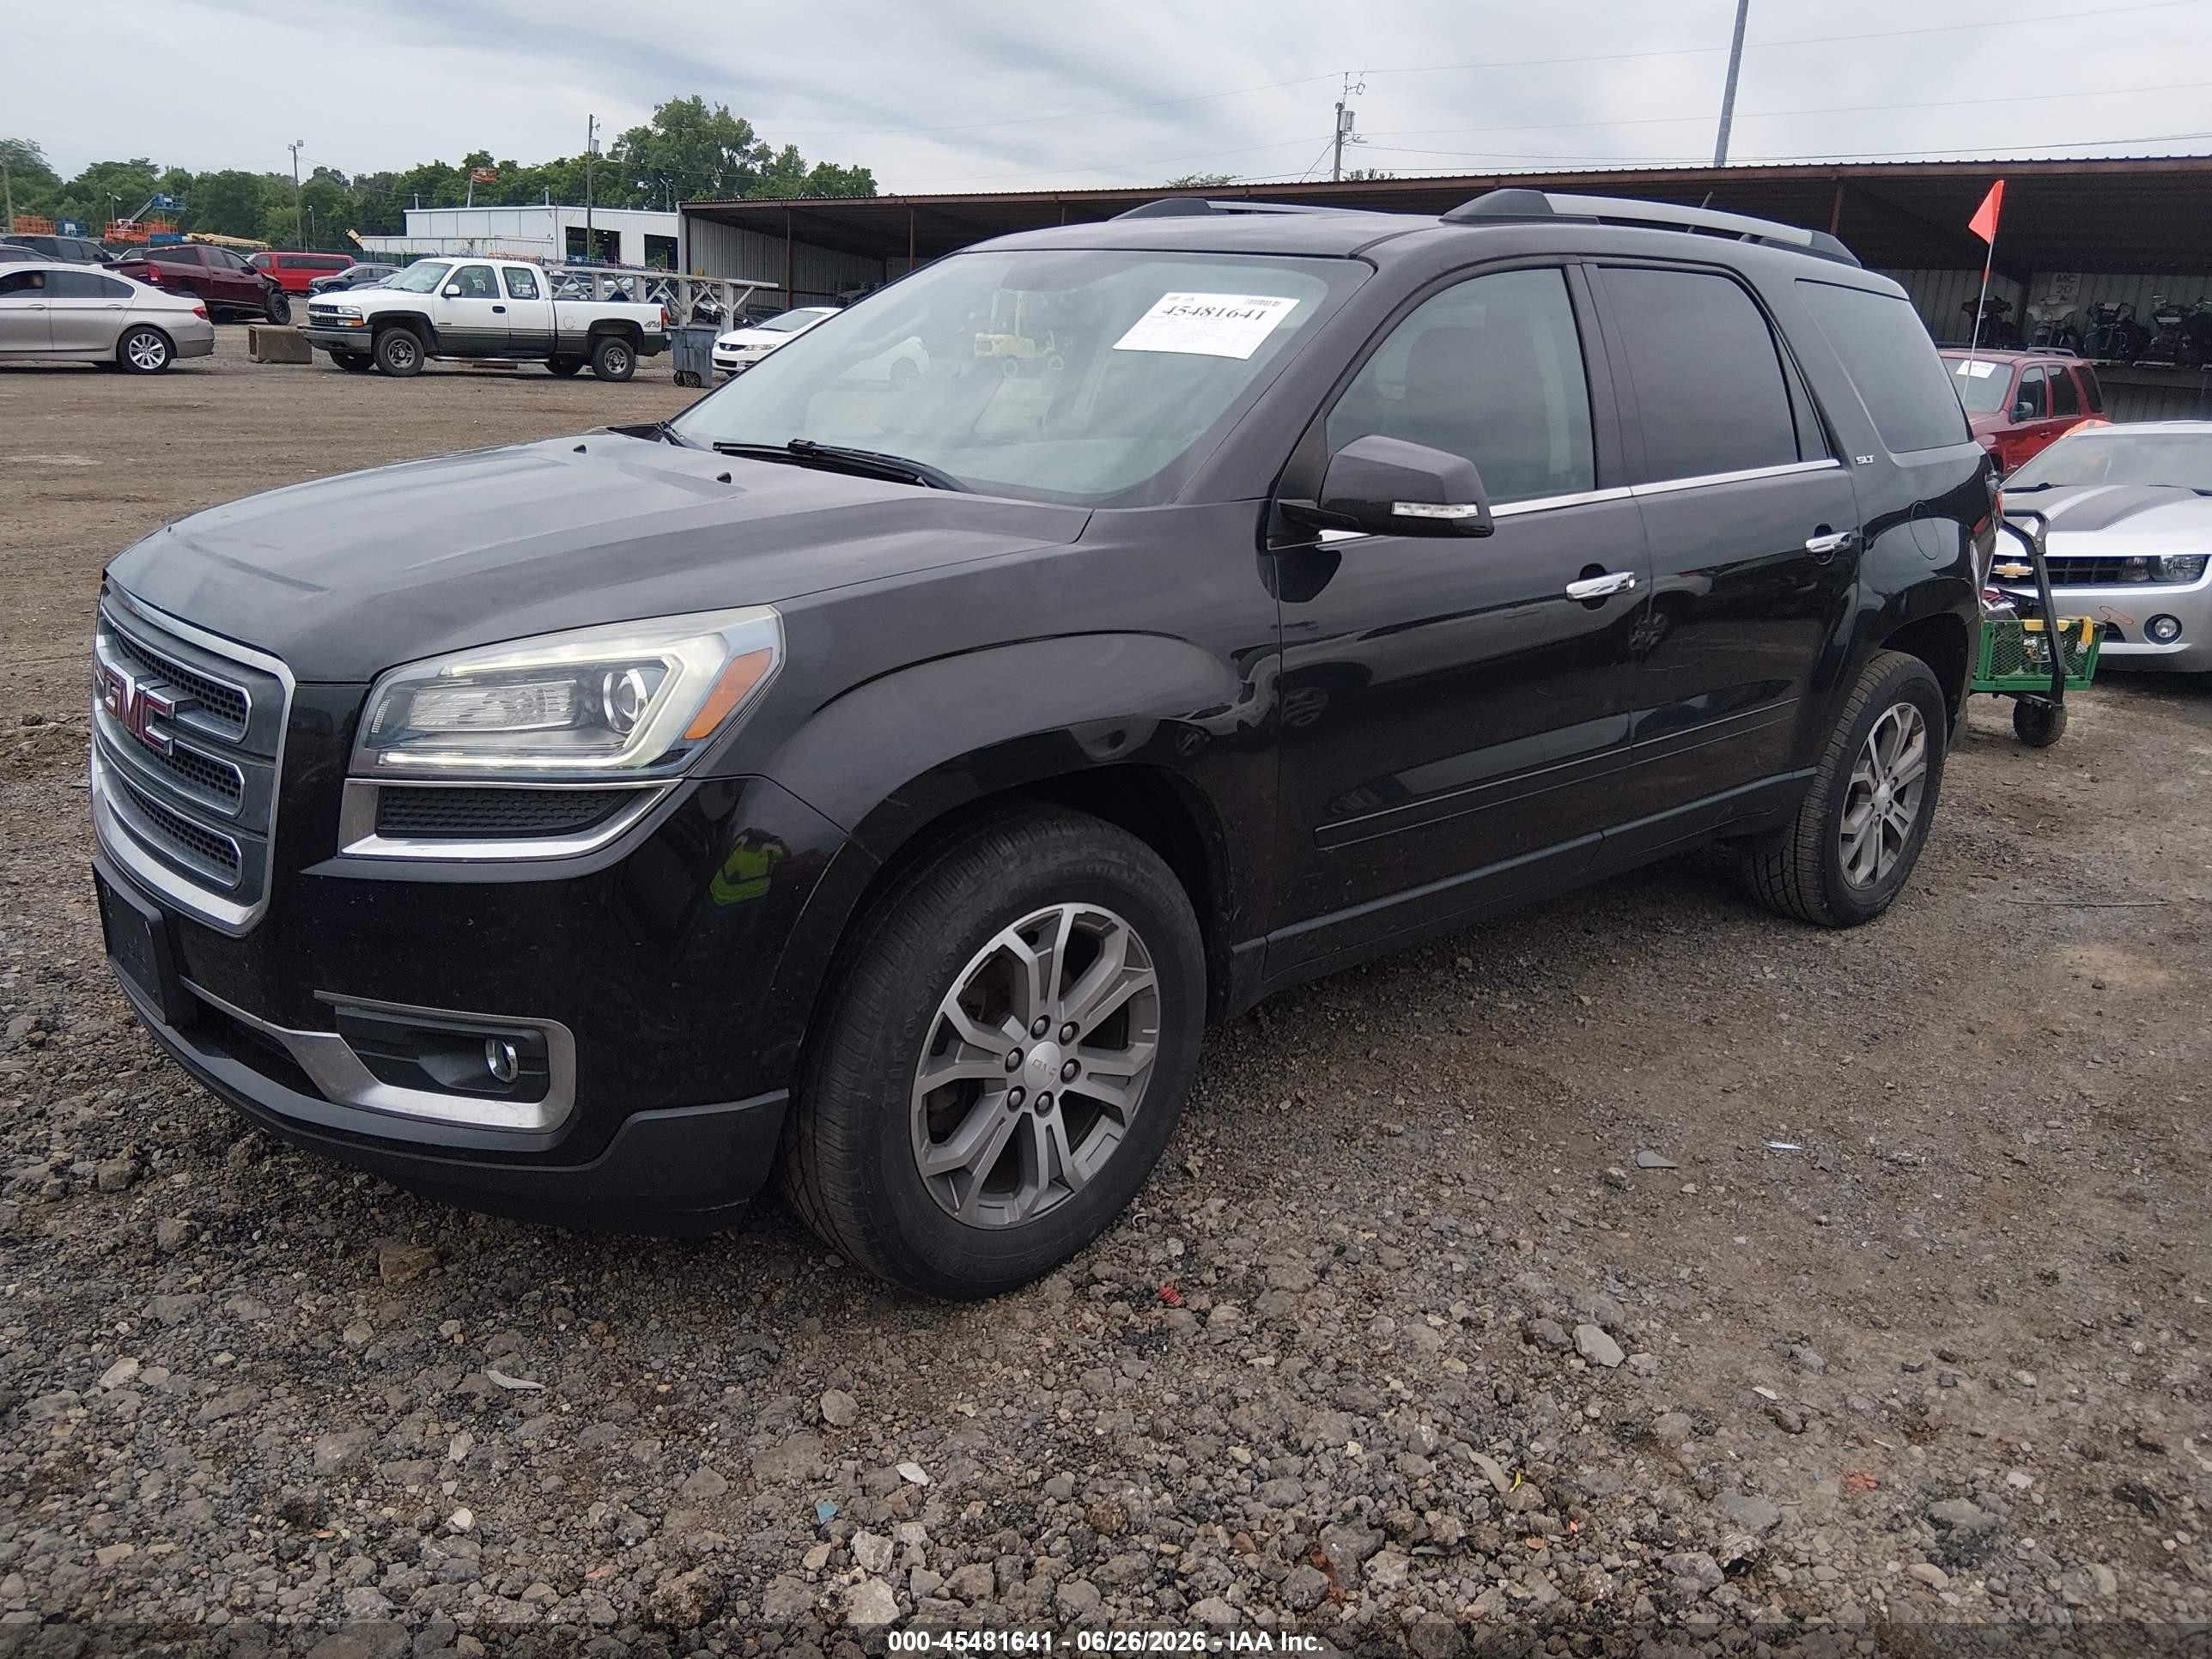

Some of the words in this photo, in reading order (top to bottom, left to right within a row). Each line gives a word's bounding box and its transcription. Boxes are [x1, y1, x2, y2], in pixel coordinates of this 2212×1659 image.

[2056, 274, 2076, 283] MC
[1162, 305, 1267, 320] 45481641
[1856, 454, 1875, 465] SLT
[104, 662, 176, 757] GMC
[1031, 1057, 1058, 1077] GMC
